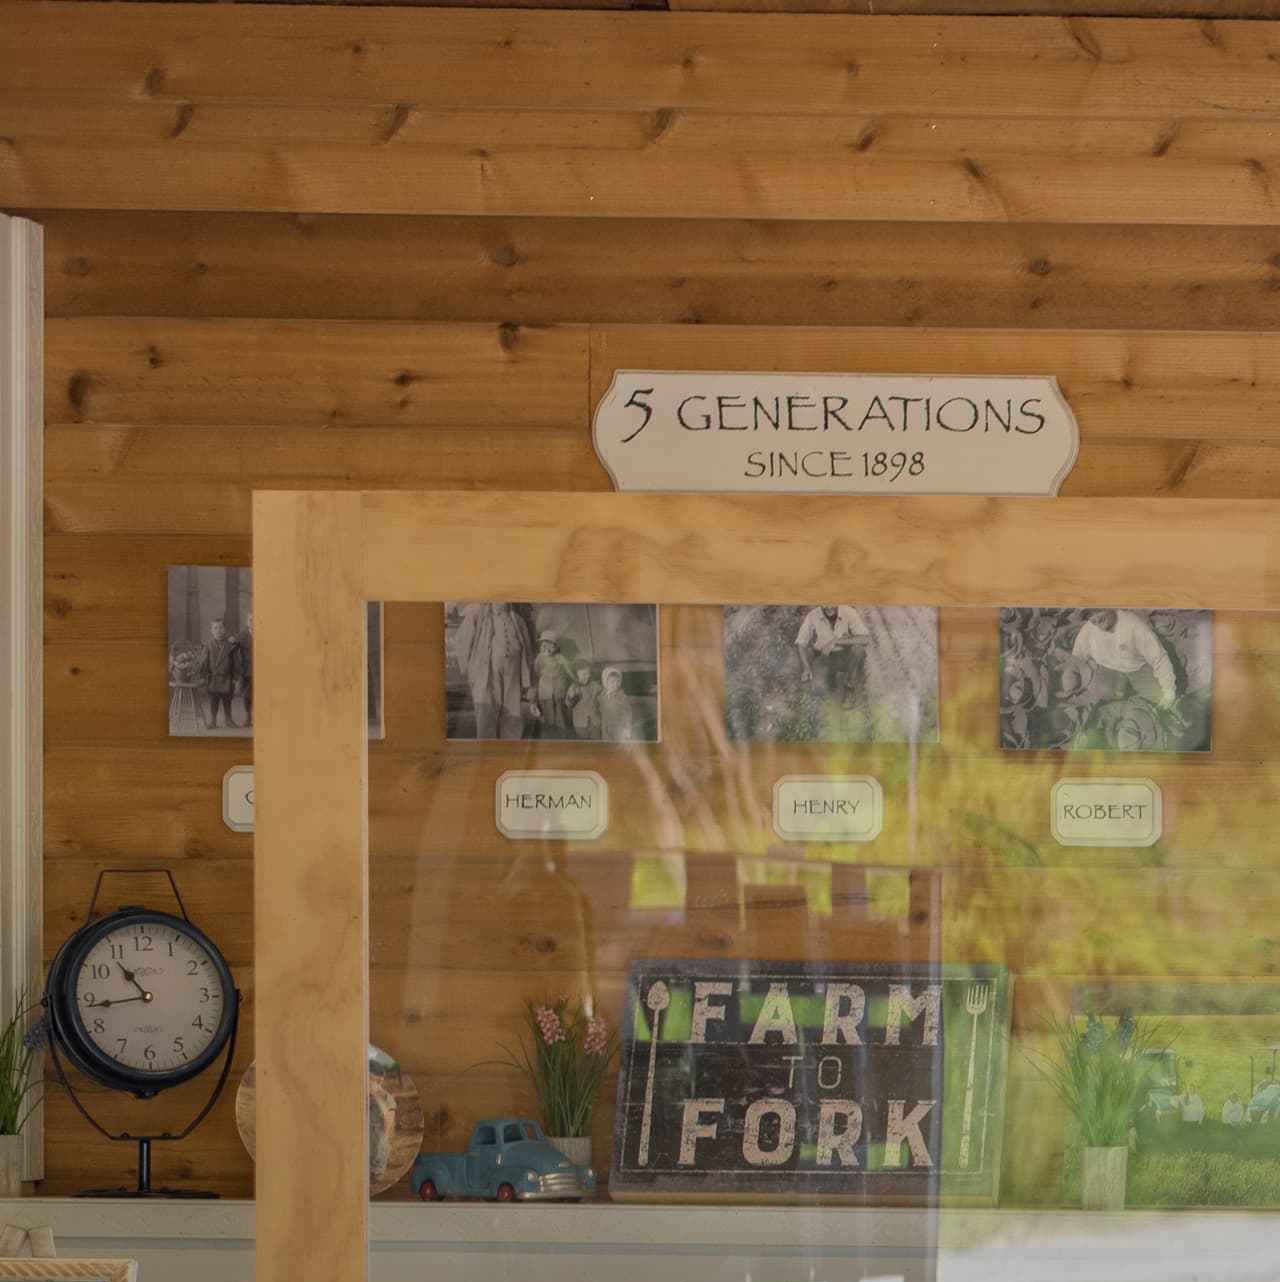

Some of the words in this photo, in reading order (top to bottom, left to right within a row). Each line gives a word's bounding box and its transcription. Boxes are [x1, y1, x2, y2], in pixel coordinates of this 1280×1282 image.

[619, 387, 655, 443] 5
[677, 394, 1047, 435] GENERATIONS
[744, 450, 853, 478] SINCE
[862, 451, 926, 483] 1898
[505, 793, 593, 811] HERMAN
[792, 798, 861, 817] HENRY
[1062, 803, 1147, 821] ROBERT
[110, 944, 124, 959] 11
[134, 935, 153, 952] 12
[167, 941, 174, 957] 1
[90, 963, 110, 980] 10
[187, 960, 199, 976] 2
[199, 987, 210, 1002] 3
[191, 1015, 204, 1030] 4
[689, 981, 944, 1047] FARM
[94, 1018, 105, 1034] 8
[117, 1038, 128, 1054] 7
[143, 1045, 156, 1060] 6
[173, 1037, 184, 1052] 5
[781, 1055, 843, 1090] TO
[676, 1098, 937, 1168] FORK
